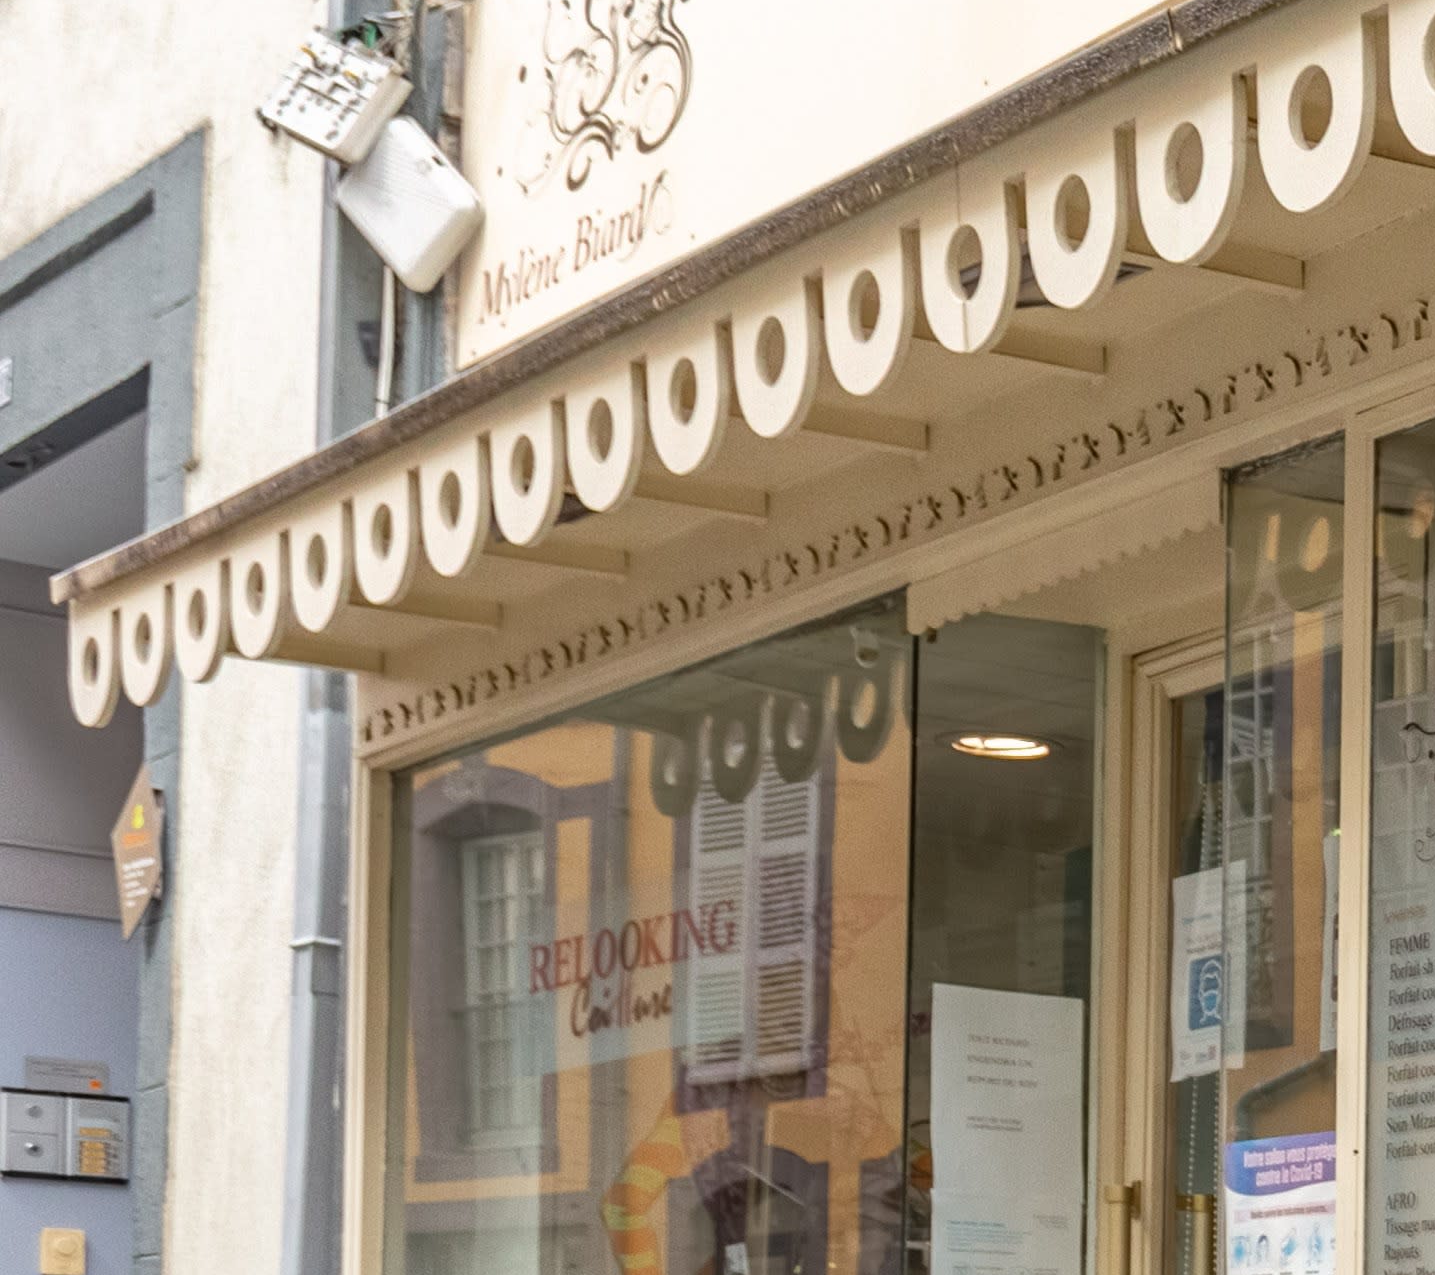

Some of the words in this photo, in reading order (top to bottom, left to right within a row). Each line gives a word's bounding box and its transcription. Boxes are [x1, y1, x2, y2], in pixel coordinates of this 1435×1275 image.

[528, 899, 738, 995] RELOOKING
[1389, 932, 1431, 955] FEMME
[1389, 962, 1420, 980] Forfait
[1388, 988, 1420, 1006] Forfait
[1388, 1039, 1419, 1058] Forfait
[1387, 1065, 1418, 1083] Forfait
[1387, 1090, 1418, 1109] Forfait
[1386, 1117, 1408, 1134] Soin
[1385, 1141, 1417, 1160] Forfait
[1290, 1161, 1323, 1182] Covid-19
[1385, 1191, 1416, 1211] AFRO
[1385, 1218, 1420, 1237] Tissage
[1384, 1243, 1420, 1264] Rajouts
